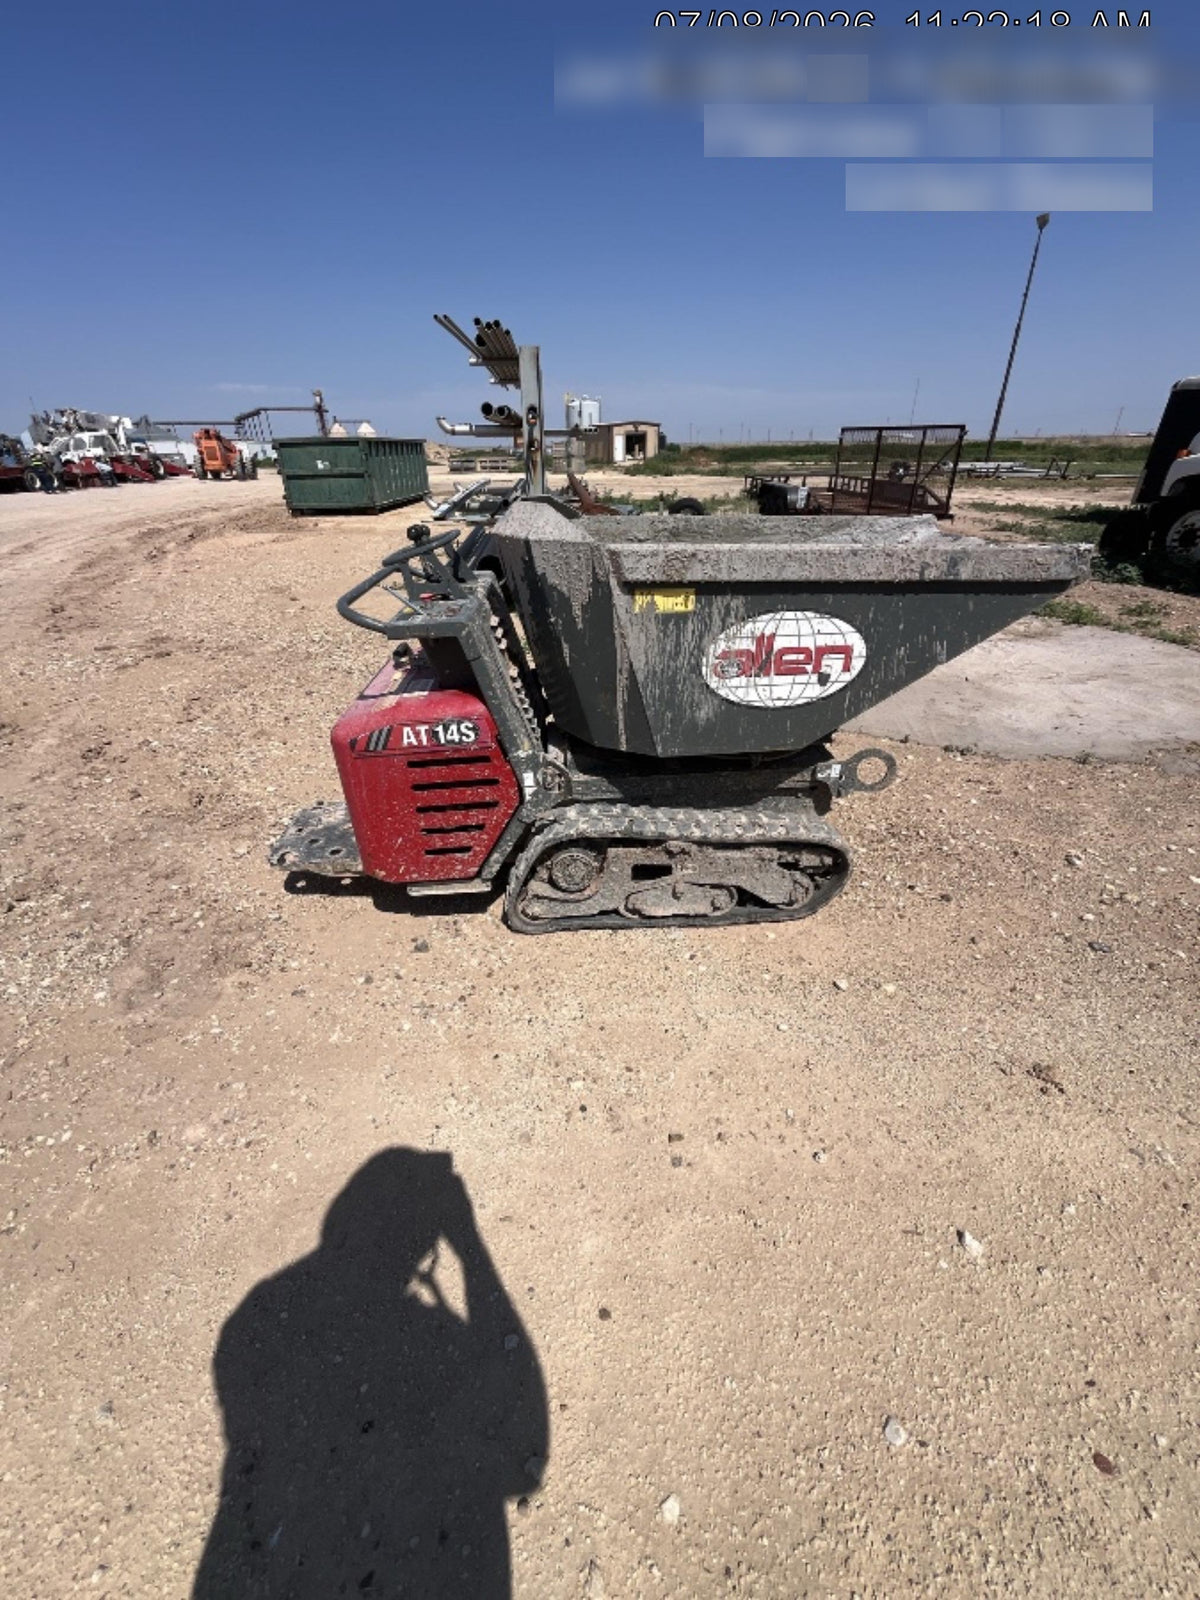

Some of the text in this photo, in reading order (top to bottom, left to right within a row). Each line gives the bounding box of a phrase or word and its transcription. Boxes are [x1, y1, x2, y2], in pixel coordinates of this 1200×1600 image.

[713, 632, 854, 679] allen
[402, 721, 477, 747] AT 14S
